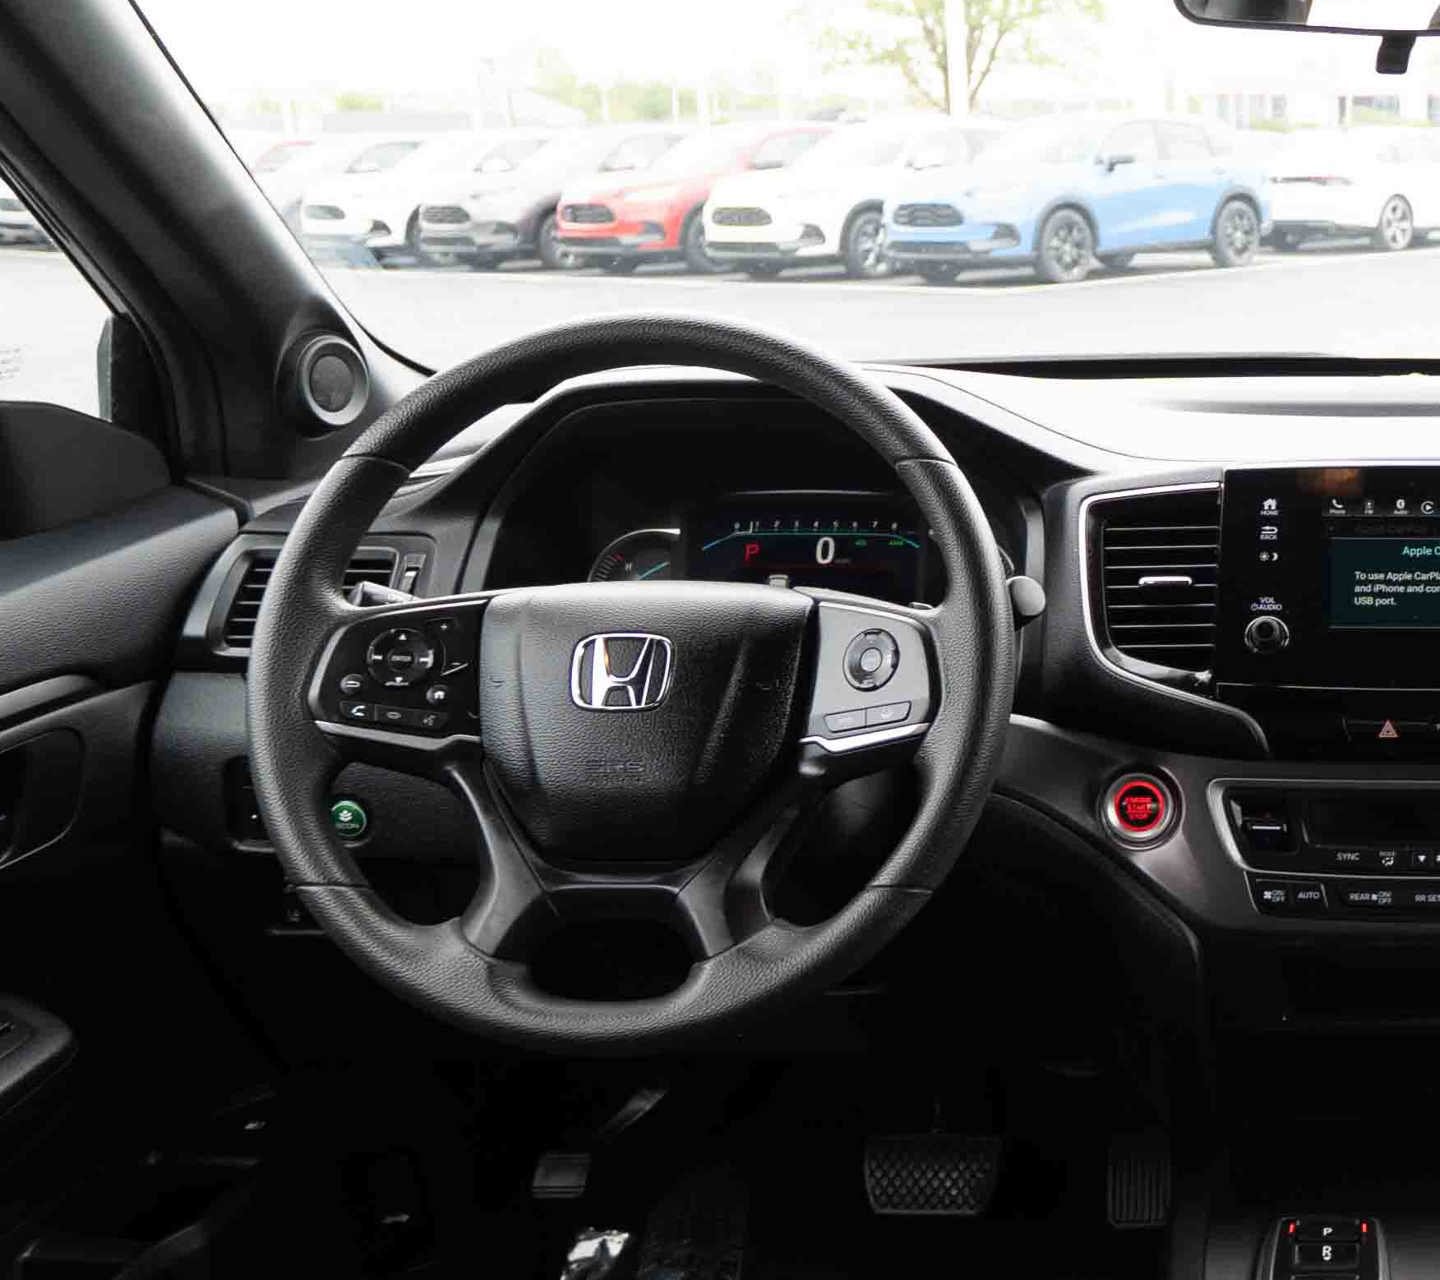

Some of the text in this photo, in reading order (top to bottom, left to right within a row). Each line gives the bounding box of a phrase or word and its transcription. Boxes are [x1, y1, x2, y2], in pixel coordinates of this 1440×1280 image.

[744, 543, 760, 561] P
[815, 536, 836, 565] 0
[1402, 545, 1432, 558] Apple
[1354, 570, 1367, 580] To
[1368, 570, 1385, 580] use
[1386, 570, 1412, 582] Apple
[1354, 583, 1372, 593] and
[1373, 583, 1404, 593] iPhone
[1406, 583, 1423, 593] and
[1354, 596, 1397, 607] USB port.
[1336, 852, 1360, 861] SYNC
[1297, 891, 1321, 900] AUTO
[1349, 893, 1370, 901] REAR
[1323, 1227, 1333, 1236] P
[1322, 1245, 1332, 1257] R
